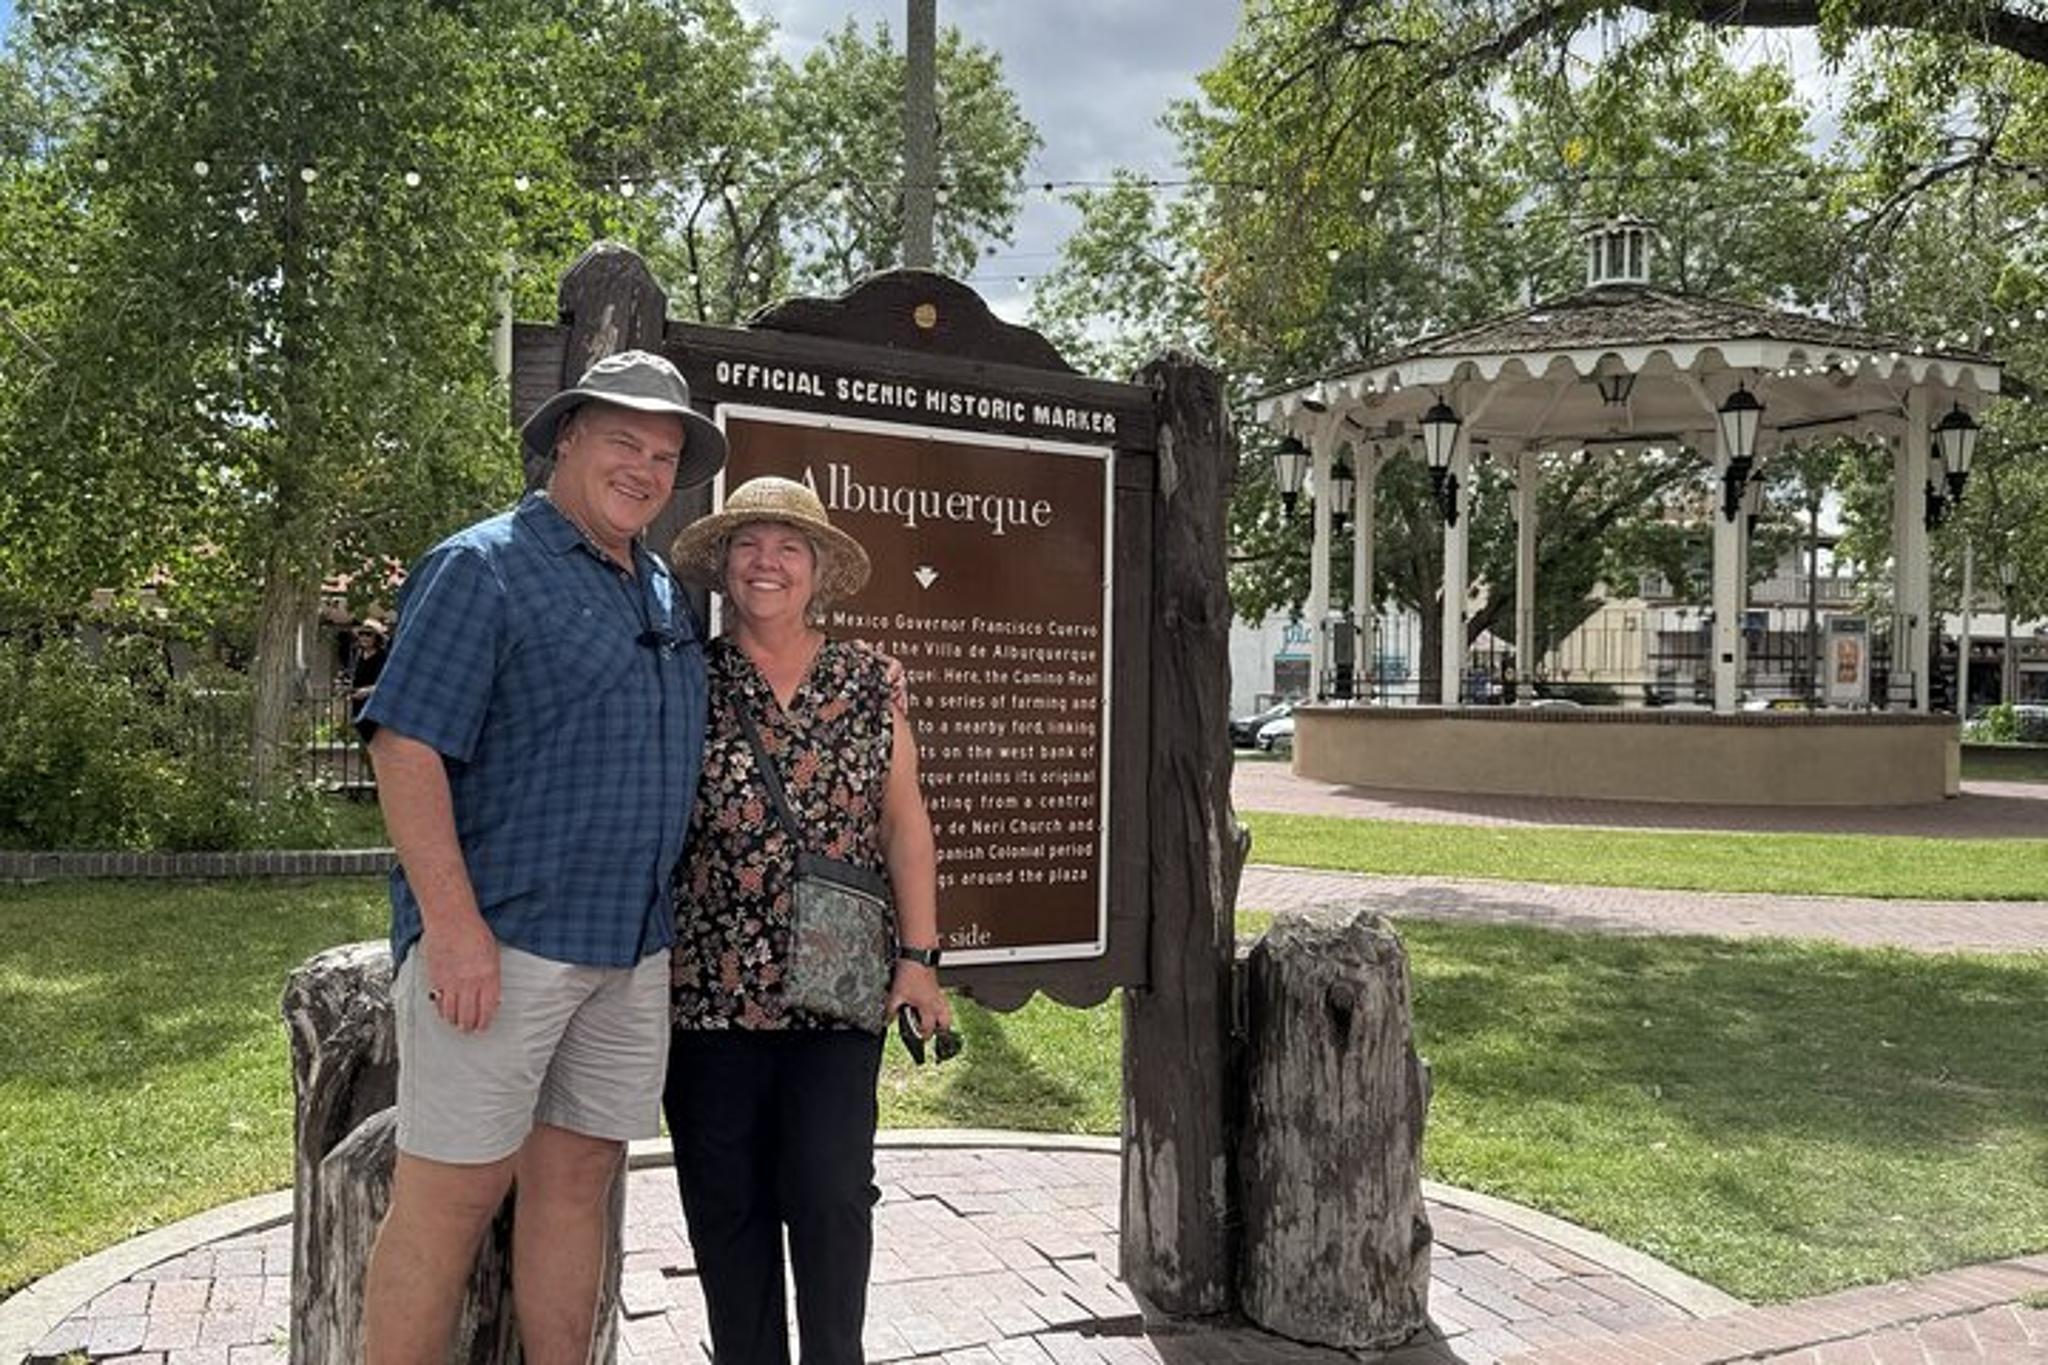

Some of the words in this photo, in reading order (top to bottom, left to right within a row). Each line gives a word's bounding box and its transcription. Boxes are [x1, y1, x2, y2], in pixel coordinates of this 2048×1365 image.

[717, 361, 825, 397] OFFICIAL
[837, 377, 917, 408] SCENIC
[926, 390, 1026, 423] HISTORIC
[1034, 404, 1117, 434] MARKER
[799, 463, 1052, 535] Albuquerque
[833, 611, 889, 629] Mexico
[896, 614, 966, 633] Governor
[972, 617, 1042, 636] Francisco
[1049, 621, 1098, 638] Cuervo
[892, 641, 918, 656] the
[924, 642, 962, 658] Villa
[969, 644, 986, 658] de
[992, 645, 1097, 663] Alburquerque
[986, 669, 1008, 684] the
[1014, 670, 1064, 685] Camino
[1068, 672, 1098, 686] Real
[924, 696, 934, 708] a
[939, 695, 985, 708] series
[990, 694, 1006, 708] of
[1011, 694, 1067, 712] farming
[1071, 696, 1097, 710] and
[918, 720, 934, 734] to
[940, 722, 950, 734] a
[956, 720, 1006, 737] nearby
[942, 747, 962, 759] on
[968, 745, 992, 759] the
[1000, 746, 1034, 759] west
[1040, 745, 1074, 759] bank
[1080, 745, 1095, 759] of
[958, 770, 1010, 784] retains
[1015, 769, 1036, 784] its
[1041, 768, 1095, 787] original
[980, 795, 1019, 809] from
[1024, 798, 1033, 808] a
[1039, 794, 1094, 808] central
[949, 821, 966, 835] de
[972, 819, 1005, 834] Neri
[1009, 818, 1062, 834] Church
[1068, 818, 1093, 832] and
[936, 842, 984, 862] panish
[988, 842, 1045, 860] Colonial
[1049, 841, 1093, 858] period
[961, 871, 1013, 886] around
[1019, 868, 1044, 882] the
[949, 924, 992, 948] side
